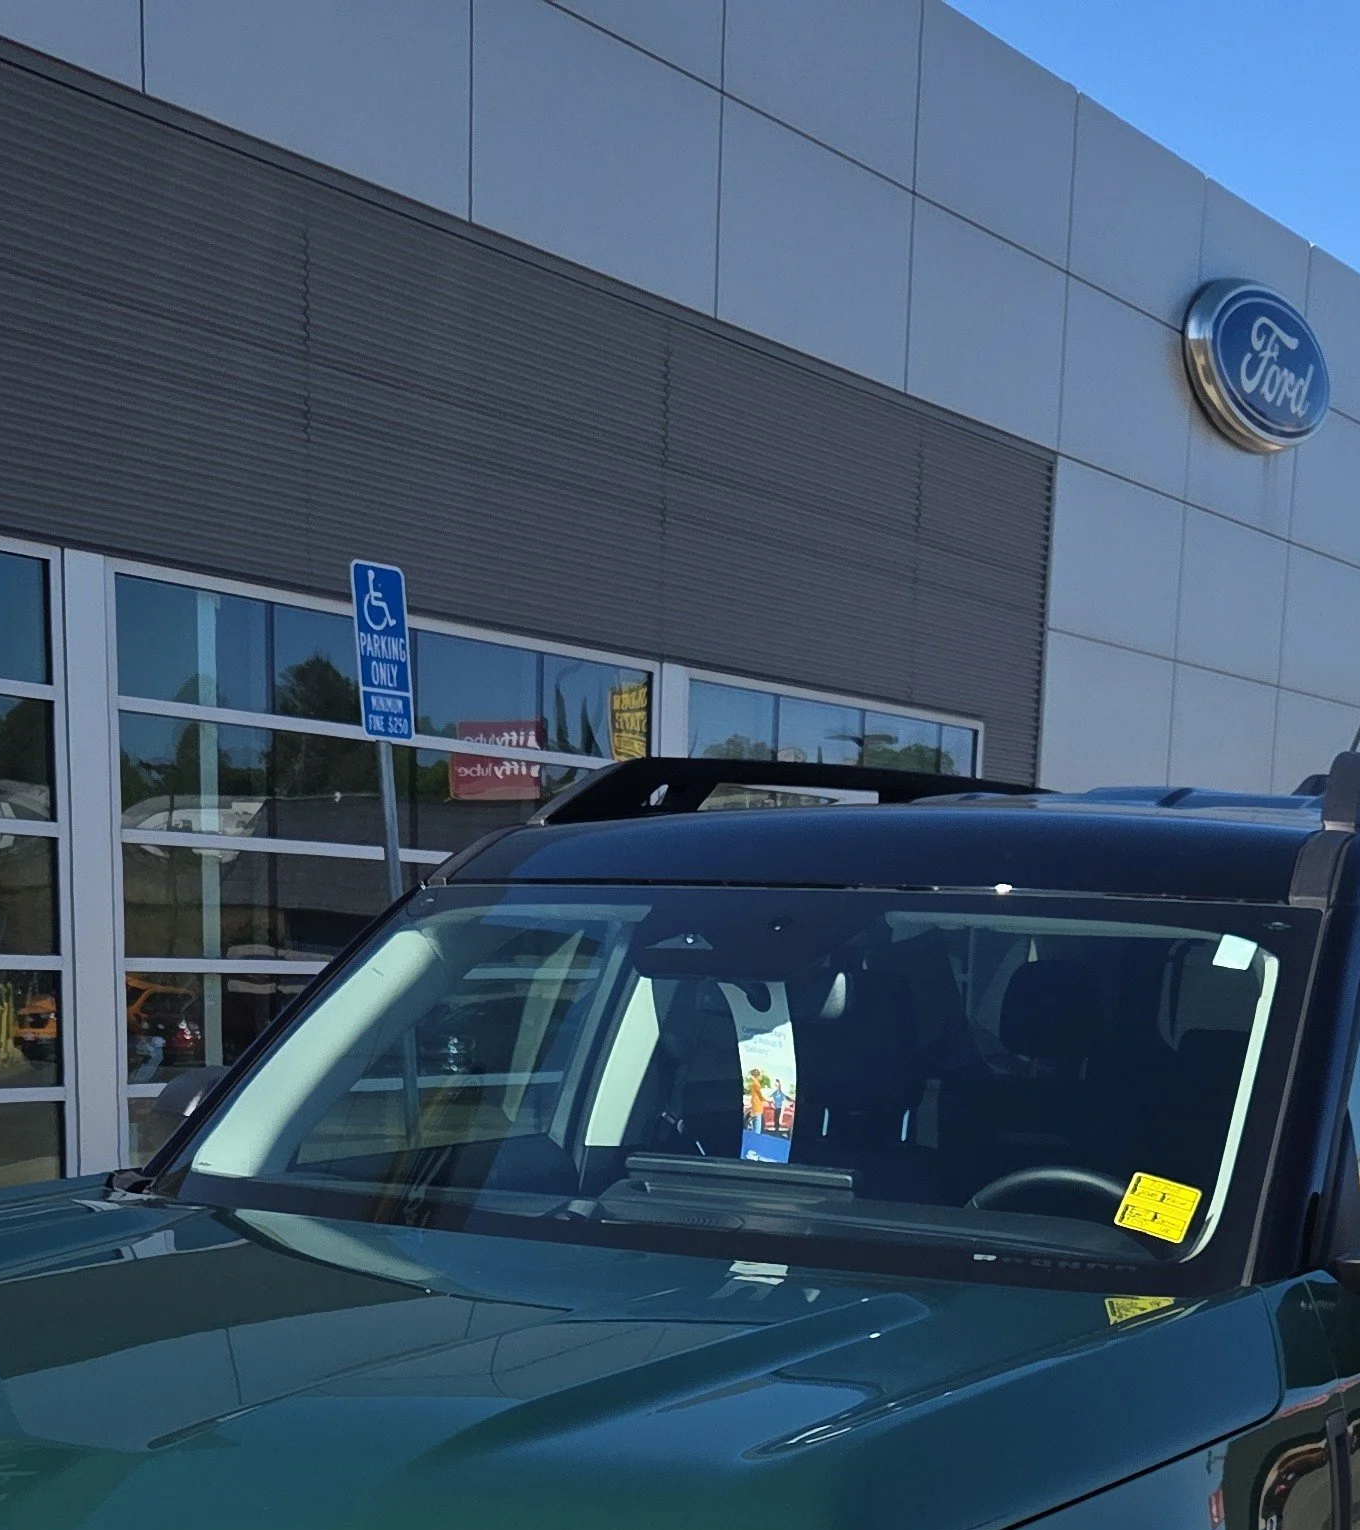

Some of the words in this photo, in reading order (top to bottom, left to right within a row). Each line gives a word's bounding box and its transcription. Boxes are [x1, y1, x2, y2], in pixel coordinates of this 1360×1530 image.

[1241, 316, 1314, 418] Ford
[359, 631, 407, 663] PARKING
[371, 661, 398, 688] ONLY
